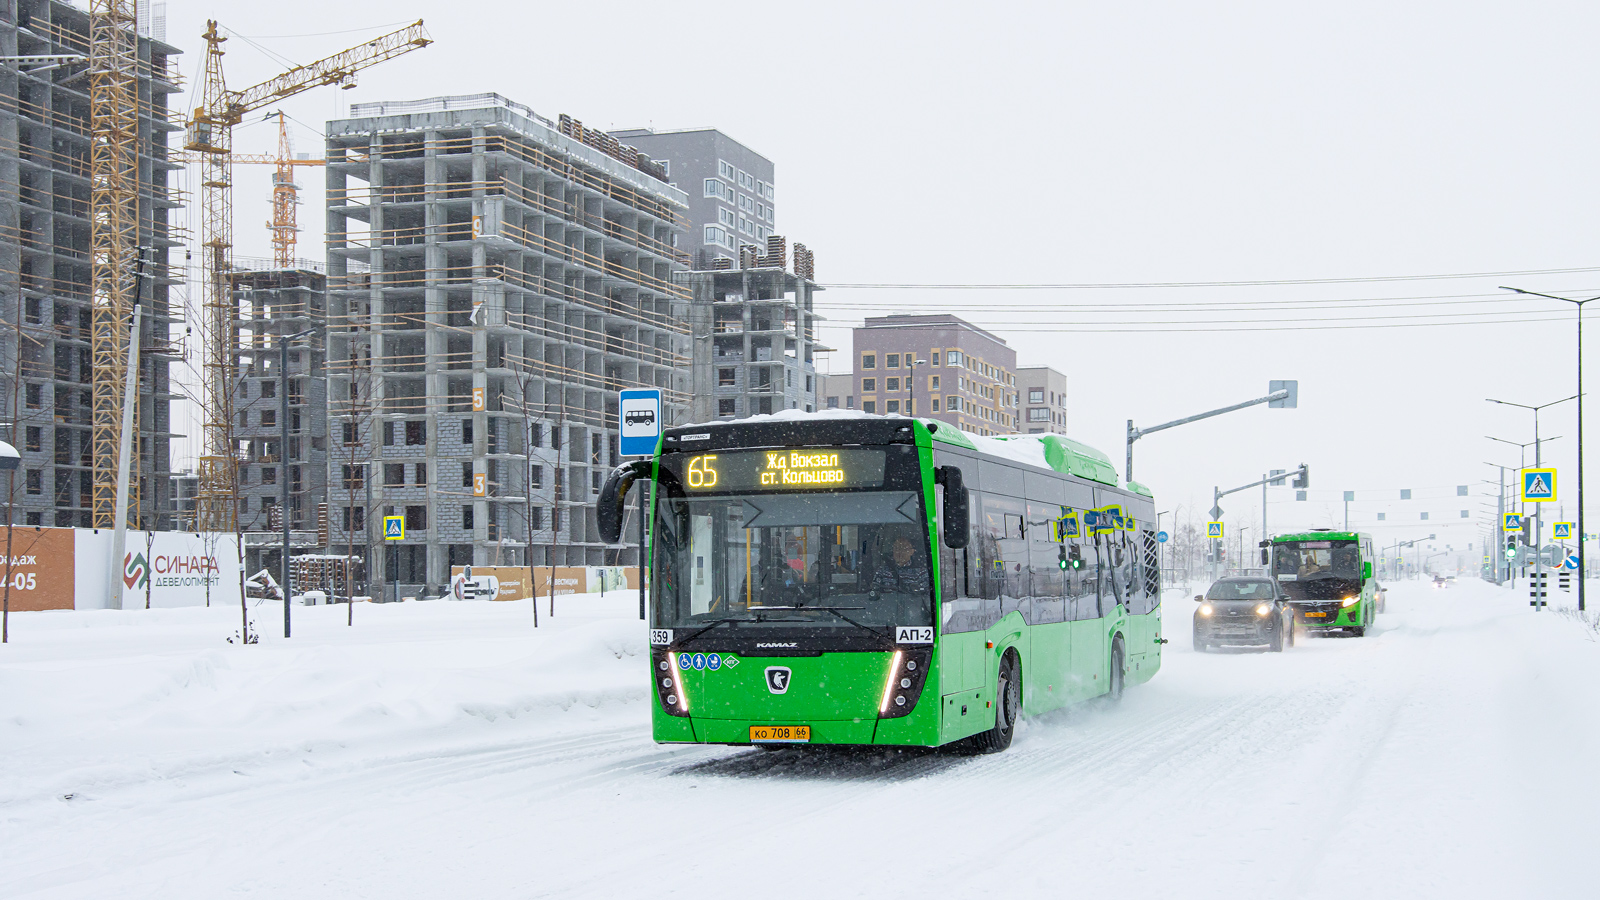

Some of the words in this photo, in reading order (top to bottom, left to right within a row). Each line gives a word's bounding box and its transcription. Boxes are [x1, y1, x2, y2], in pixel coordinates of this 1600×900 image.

[474, 390, 483, 408] 5
[766, 453, 787, 470] Жд
[790, 452, 838, 468] Вокзал
[688, 455, 717, 487] 65
[761, 472, 779, 485] ст.
[782, 468, 844, 484] Кольцово
[475, 476, 484, 493] 3
[154, 555, 220, 574] СИНАРА
[155, 577, 220, 587] ДЕВЕЛОПМЕНТ
[546, 575, 579, 586] Ивестиции
[652, 631, 668, 643] 359
[899, 629, 931, 641] АП-2
[771, 728, 790, 738] 708
[796, 727, 806, 735] 66
